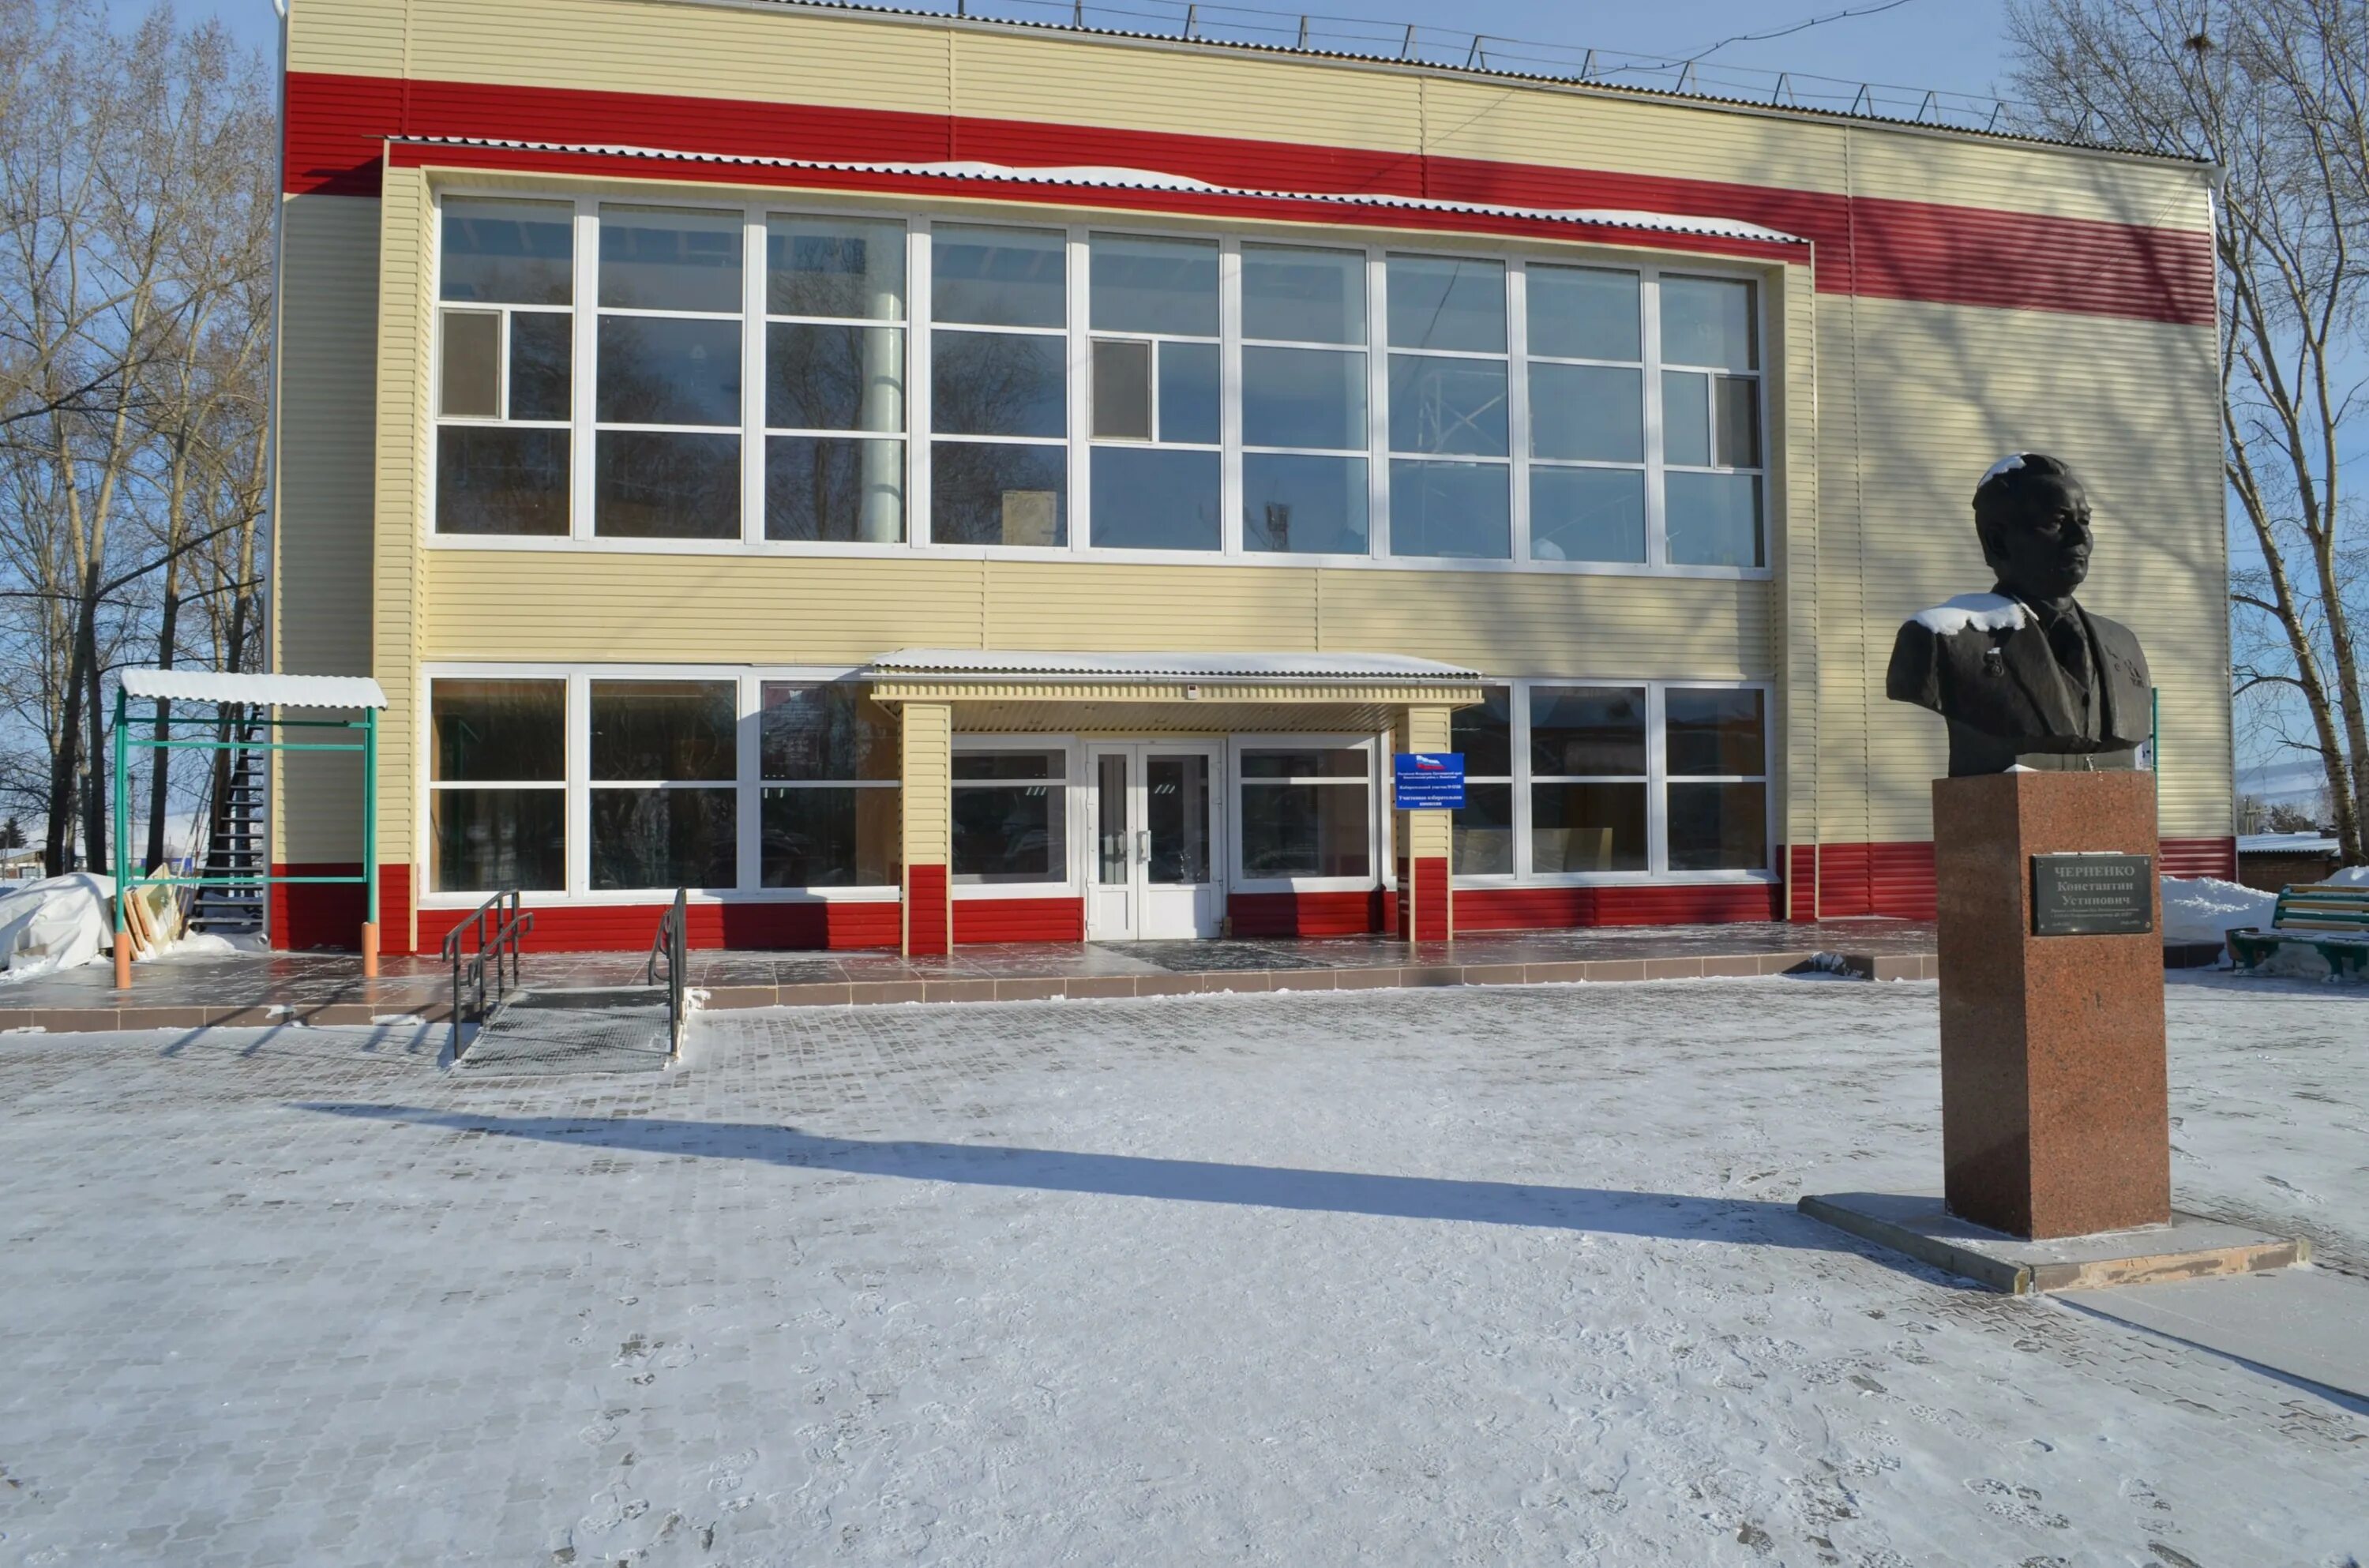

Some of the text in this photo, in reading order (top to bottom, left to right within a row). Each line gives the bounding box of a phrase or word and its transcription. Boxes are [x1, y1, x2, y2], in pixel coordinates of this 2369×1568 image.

[2054, 866, 2134, 877] ЧЕРНЕНКО
[2057, 881, 2134, 891] Константин
[2062, 895, 2130, 906] Устинович
